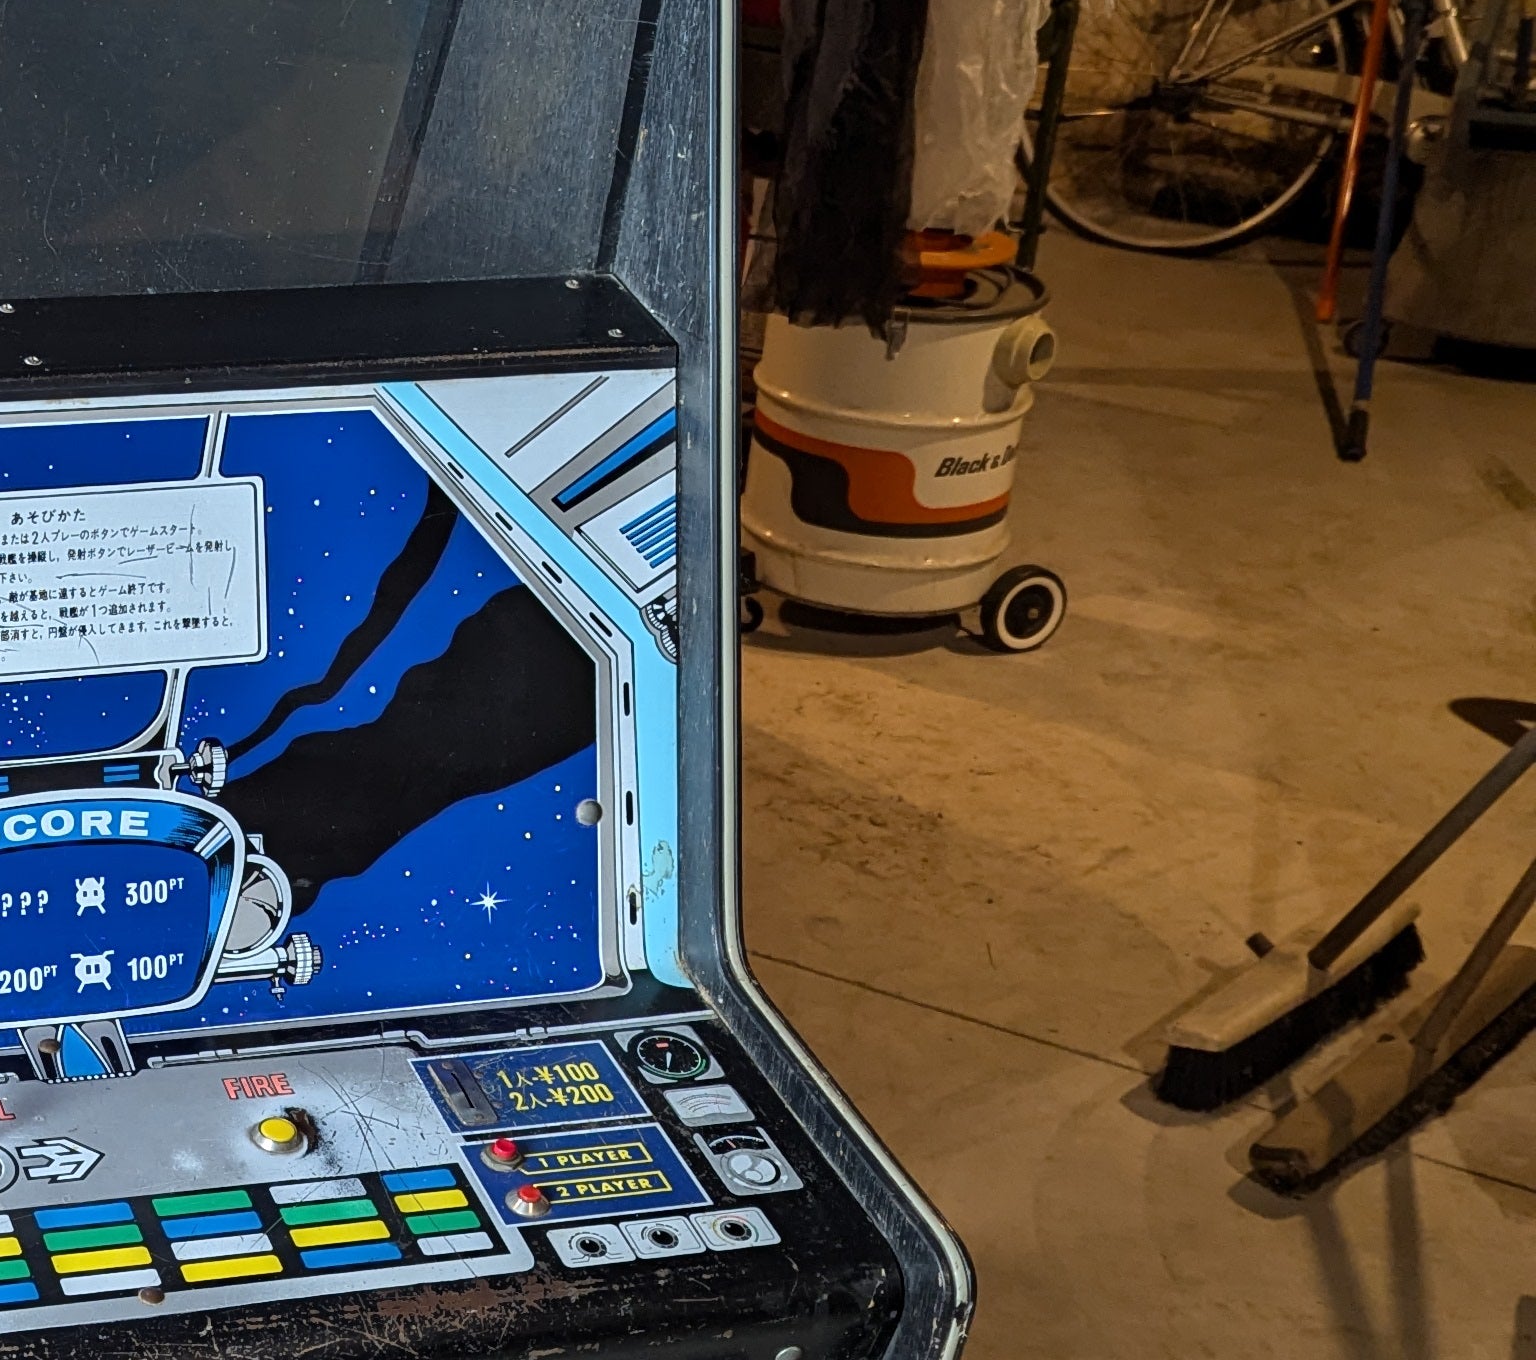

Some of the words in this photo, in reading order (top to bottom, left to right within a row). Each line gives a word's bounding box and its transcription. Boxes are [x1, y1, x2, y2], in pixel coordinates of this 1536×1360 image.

[934, 452, 990, 477] Black
[10, 509, 86, 526] あそびかた
[223, 1073, 292, 1100] FIRE
[537, 1157, 550, 1168] 1
[556, 1149, 633, 1167] PLAYER
[556, 1186, 571, 1198] 2
[575, 1178, 653, 1196] PLAYER
